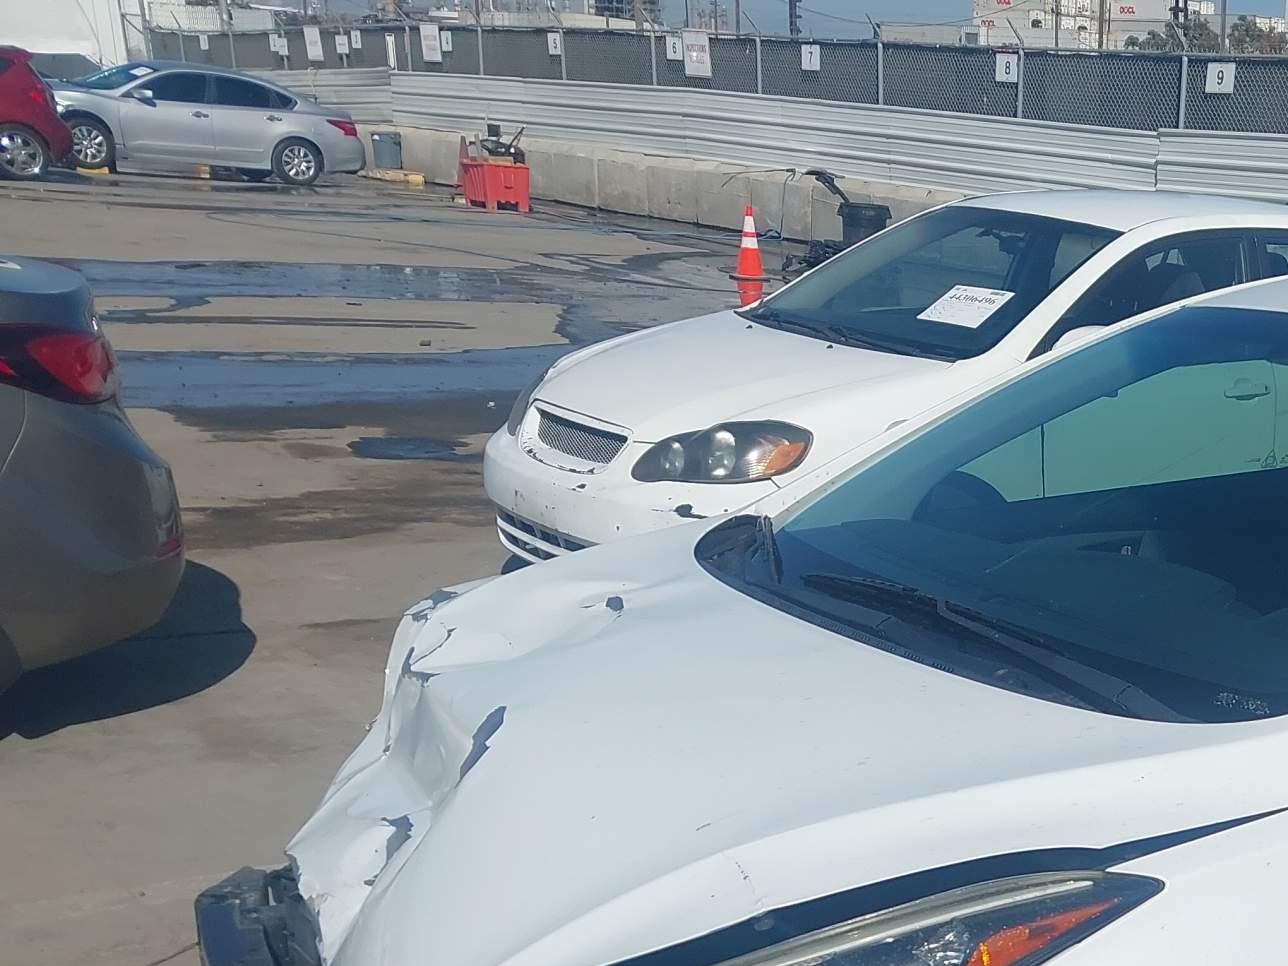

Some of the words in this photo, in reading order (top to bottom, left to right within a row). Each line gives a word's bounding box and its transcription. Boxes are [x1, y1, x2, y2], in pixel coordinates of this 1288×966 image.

[552, 38, 559, 49] 5
[671, 41, 678, 55] 6
[807, 51, 814, 64] 7
[1003, 60, 1012, 76] 8
[1215, 69, 1226, 86] 9
